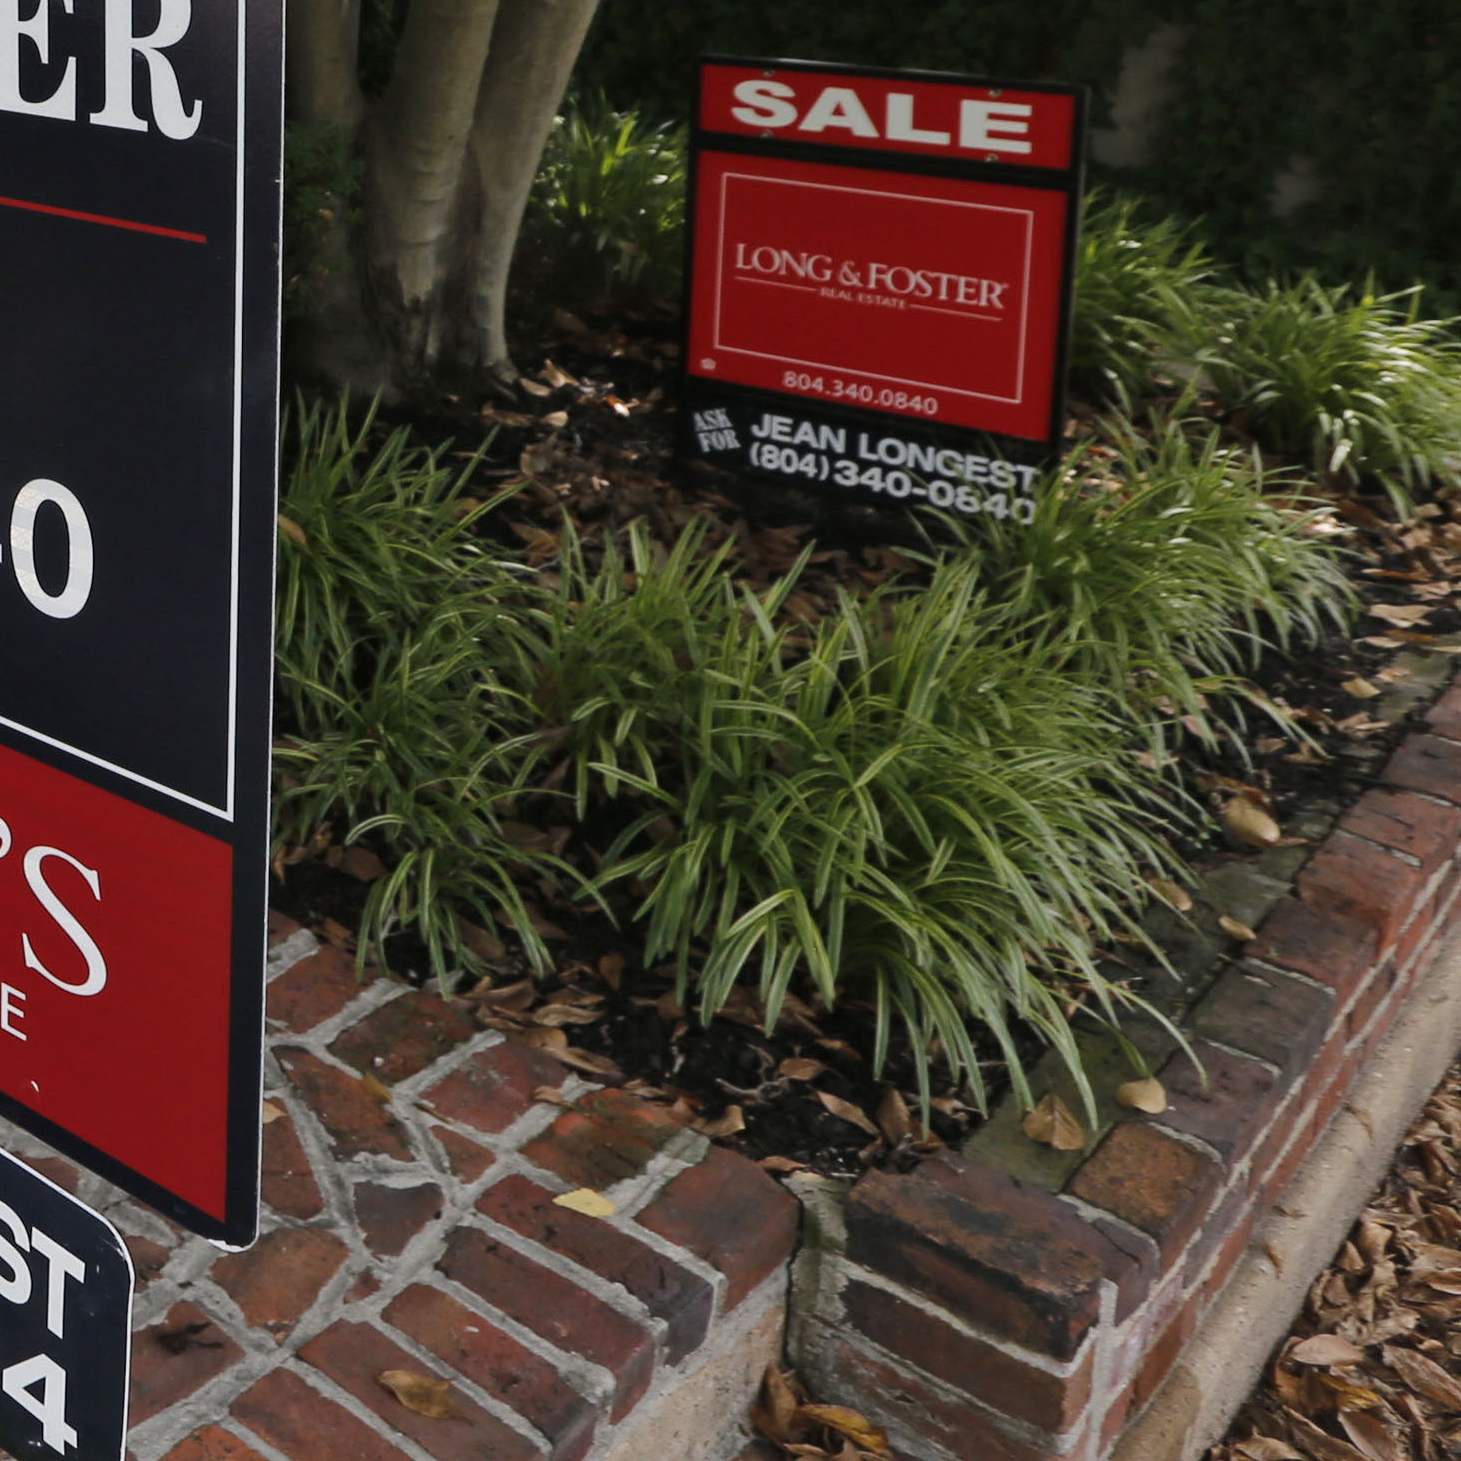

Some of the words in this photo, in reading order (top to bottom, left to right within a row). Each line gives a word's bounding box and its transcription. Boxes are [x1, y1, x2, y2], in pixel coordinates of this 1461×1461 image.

[731, 79, 1033, 155] SALE
[735, 243, 832, 282] LONG
[838, 260, 863, 287] &
[820, 287, 854, 303] REAL
[858, 293, 907, 310] ESTATE
[783, 370, 939, 416] 804.340.0840
[693, 408, 733, 432] ASK
[698, 429, 741, 453] FOR
[751, 413, 847, 453] JEAN
[858, 433, 1039, 492] LONGEST
